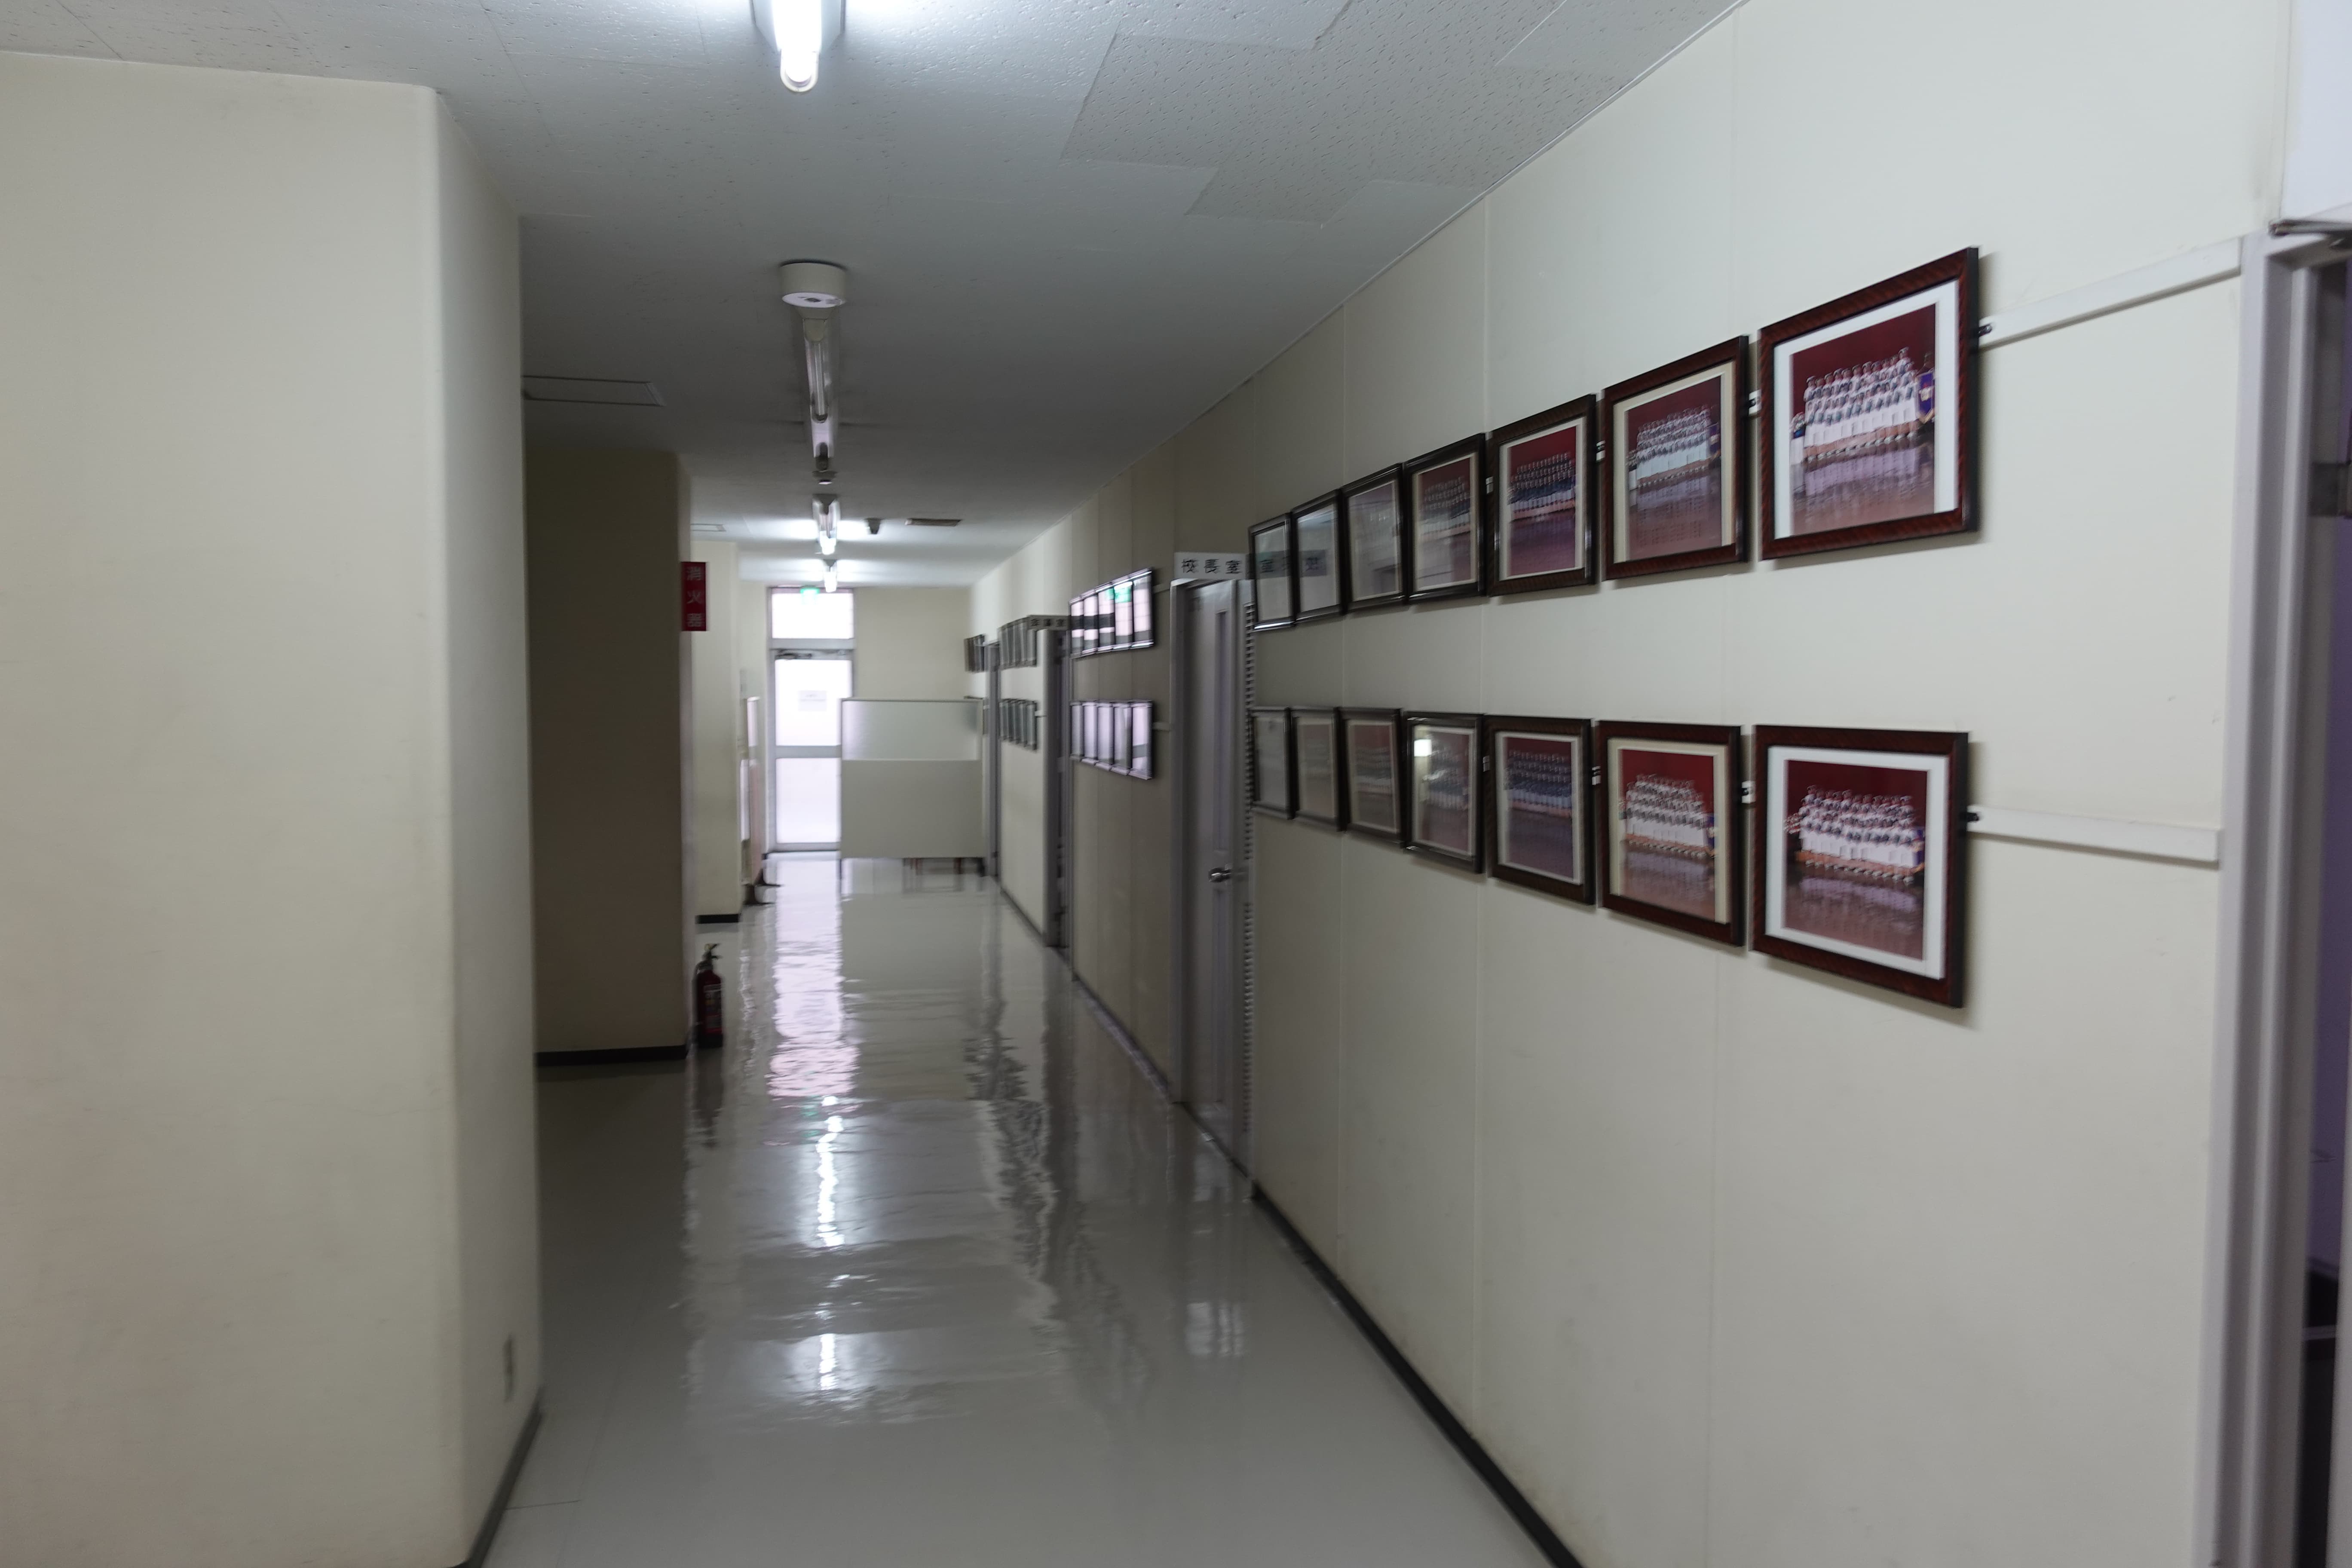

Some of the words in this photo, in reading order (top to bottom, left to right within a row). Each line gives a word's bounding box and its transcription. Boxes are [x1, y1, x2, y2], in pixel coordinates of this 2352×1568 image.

[1181, 559, 1242, 574] 校長室
[687, 566, 702, 627] 消火器
